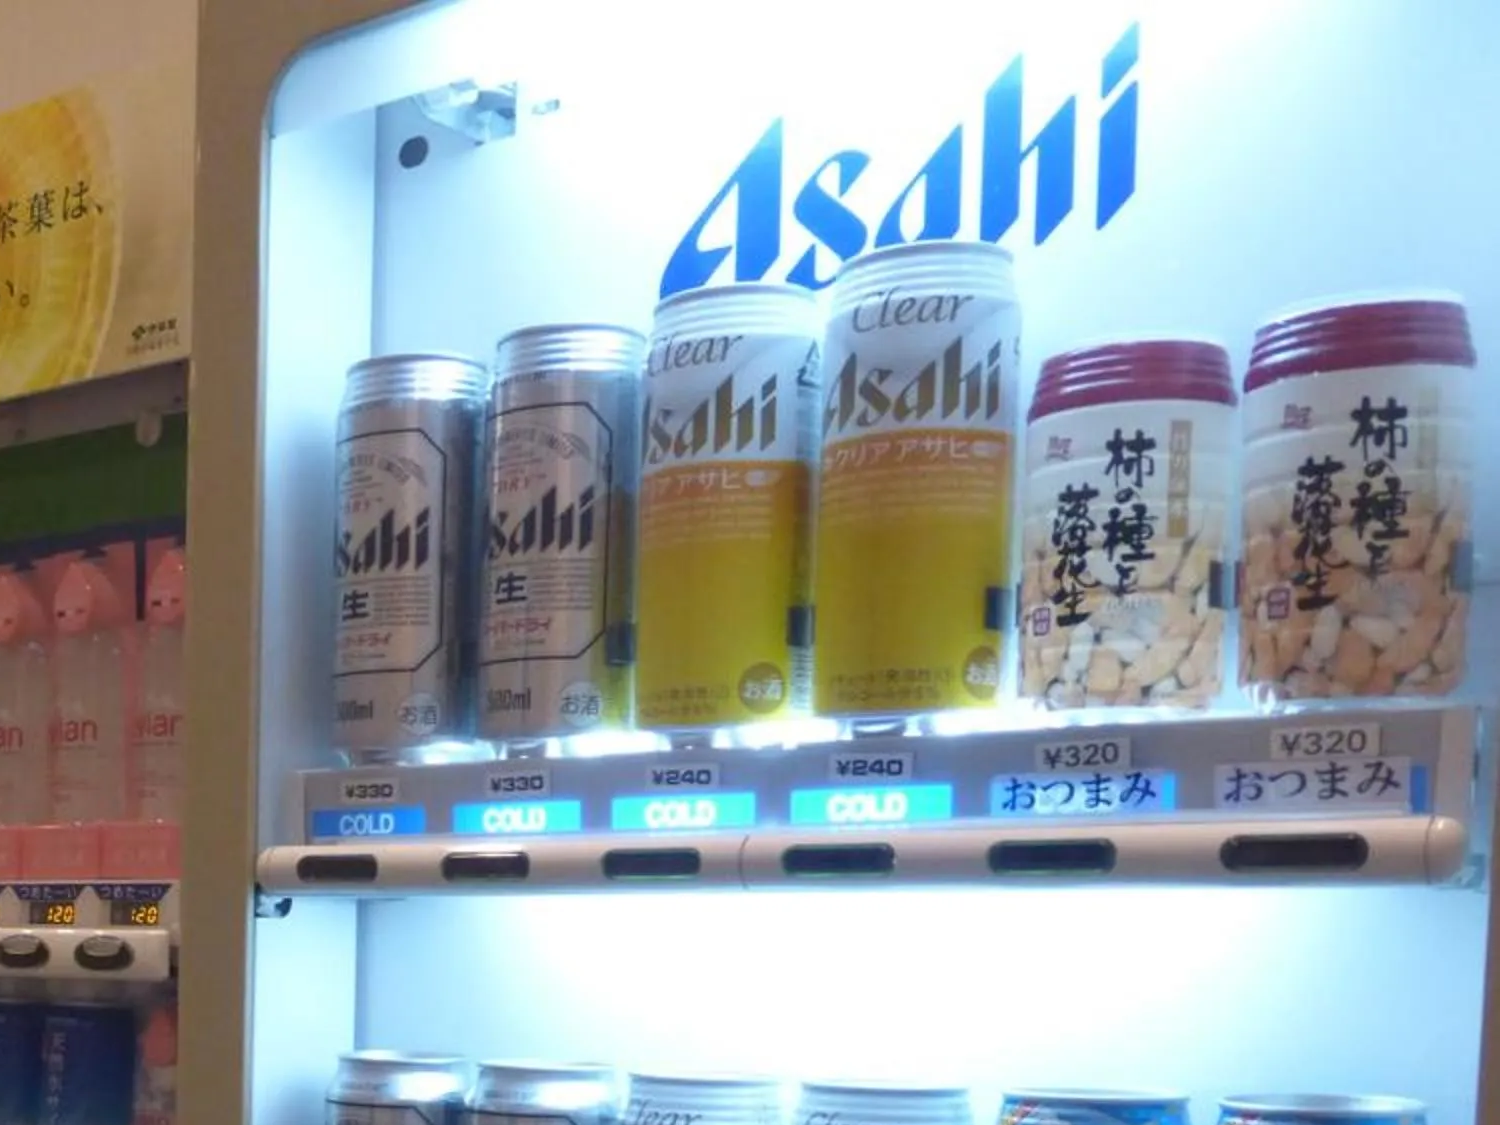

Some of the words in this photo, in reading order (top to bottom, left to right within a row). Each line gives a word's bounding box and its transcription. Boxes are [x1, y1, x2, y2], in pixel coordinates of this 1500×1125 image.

[659, 20, 1140, 300] Asahi
[852, 290, 975, 335] Clear
[822, 334, 1002, 441] Asahi
[337, 504, 431, 578] sahi
[495, 571, 528, 606] 生
[342, 589, 371, 621] 生
[1041, 742, 1121, 769] ¥320
[1279, 729, 1367, 757] ¥320
[650, 768, 712, 788] ¥240
[835, 756, 904, 778] ¥240
[1222, 759, 1403, 803] おつまみ
[344, 781, 395, 801] ¥330
[489, 773, 545, 795] ¥330
[1001, 771, 1157, 811] おつまみ
[481, 804, 547, 834] COLD
[643, 797, 718, 830] COLD
[826, 790, 909, 824] COLD
[338, 813, 396, 836] COLD
